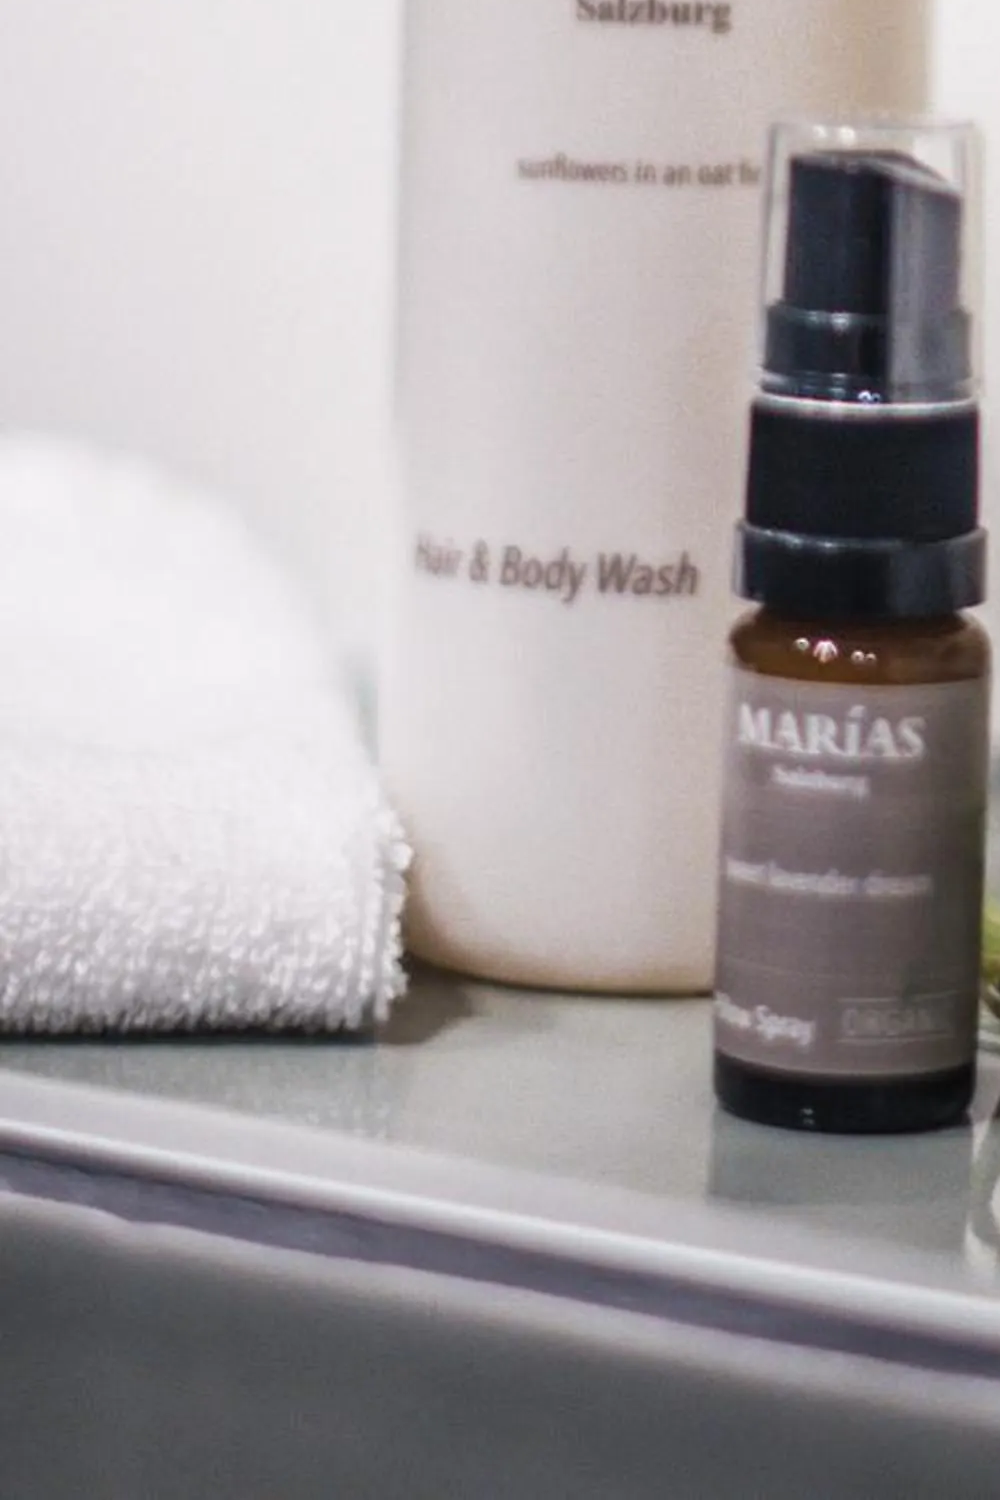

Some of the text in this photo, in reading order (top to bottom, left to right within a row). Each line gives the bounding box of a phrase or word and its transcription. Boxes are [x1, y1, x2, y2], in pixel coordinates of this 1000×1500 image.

[634, 159, 656, 183] in
[469, 538, 490, 582] &
[499, 544, 588, 604] Body
[597, 550, 700, 596] Wash
